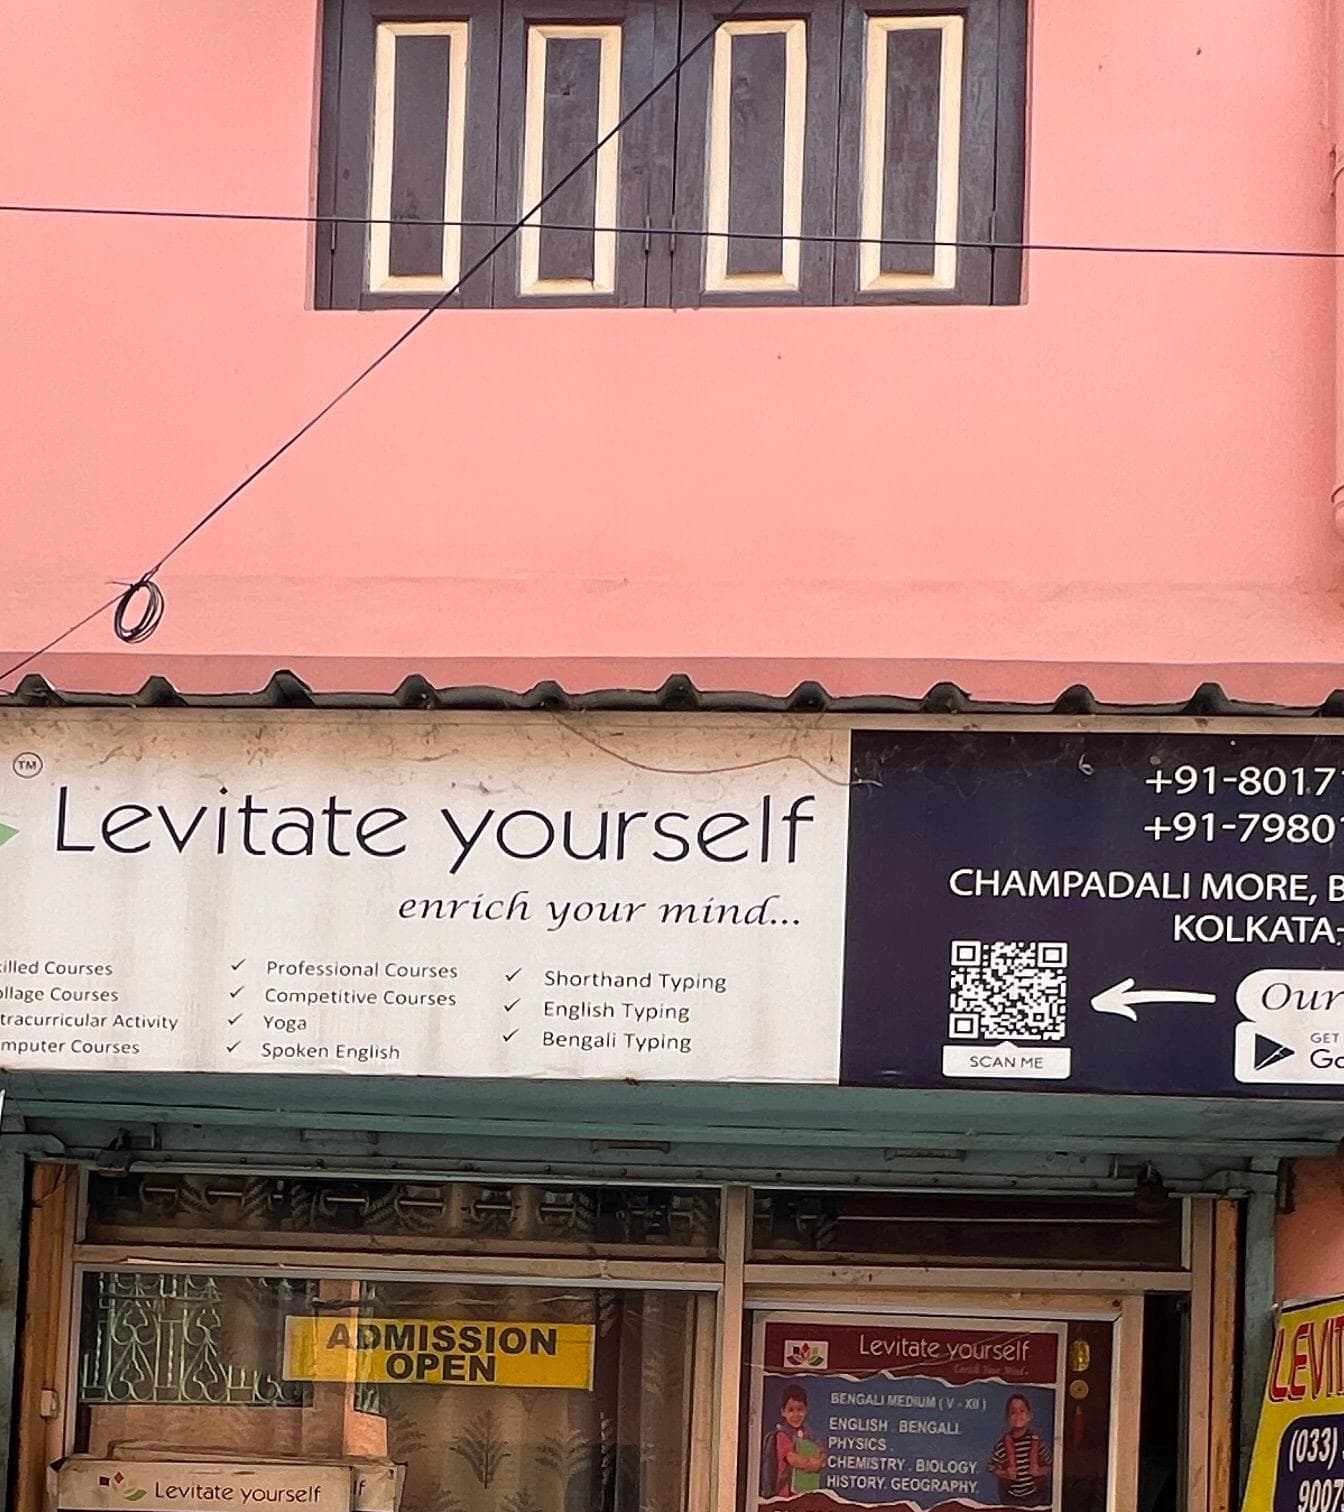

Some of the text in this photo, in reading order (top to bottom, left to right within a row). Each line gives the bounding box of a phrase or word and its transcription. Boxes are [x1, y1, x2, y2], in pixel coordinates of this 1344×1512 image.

[56, 786, 816, 875] Levitate yourself
[949, 868, 1191, 902] CHAMPADALI
[1200, 873, 1317, 906] MORE,
[398, 890, 800, 931] enrich your mind...
[45, 959, 113, 977] Courses
[266, 960, 459, 981] Professional Courses
[51, 985, 119, 1003] Courses
[544, 969, 728, 995] Shorthand Typing
[265, 986, 457, 1009] Competitive Courses
[112, 1012, 178, 1032] Activity
[263, 1014, 307, 1035] Yoga
[543, 1000, 690, 1025] English Typing
[70, 1038, 140, 1056] Courses
[261, 1041, 401, 1066] Spoken English
[542, 1031, 692, 1055] Bengali Typing
[969, 1055, 1043, 1070] SCAN ME
[326, 1322, 558, 1356] ADMISSION
[859, 1334, 1029, 1362] Levitate yourself
[385, 1353, 496, 1383] OPEN
[1288, 1421, 1339, 1475] (033)
[155, 1481, 321, 1504] Levitate yourself
